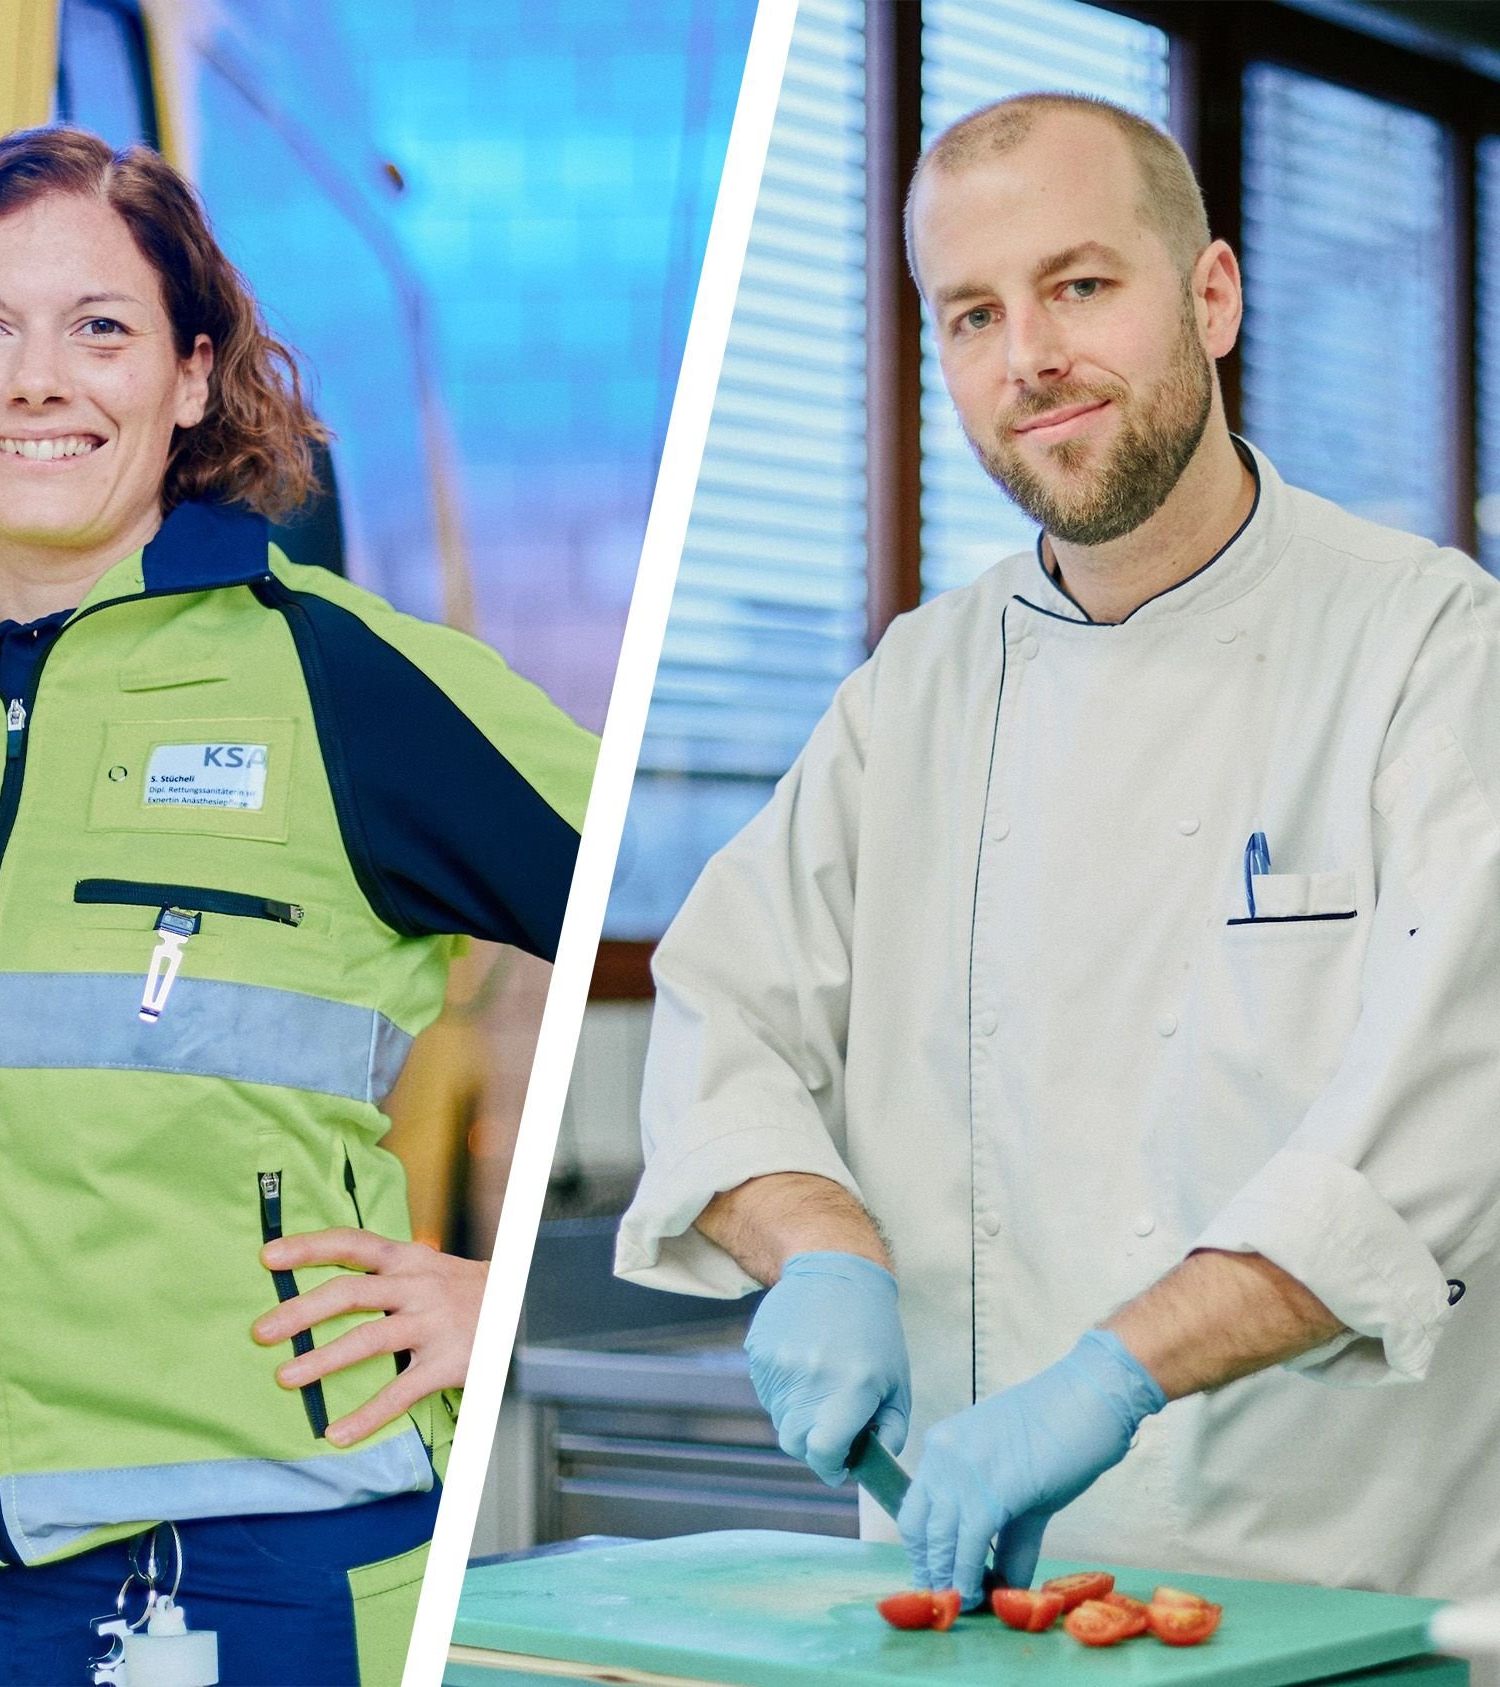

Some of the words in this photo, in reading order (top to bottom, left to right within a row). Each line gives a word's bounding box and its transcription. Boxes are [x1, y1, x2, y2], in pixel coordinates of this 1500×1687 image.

[203, 747, 266, 769] KSA
[161, 775, 195, 783] Stücheli
[149, 786, 165, 795] Dipl.
[181, 797, 248, 808] Anästhesiepge
